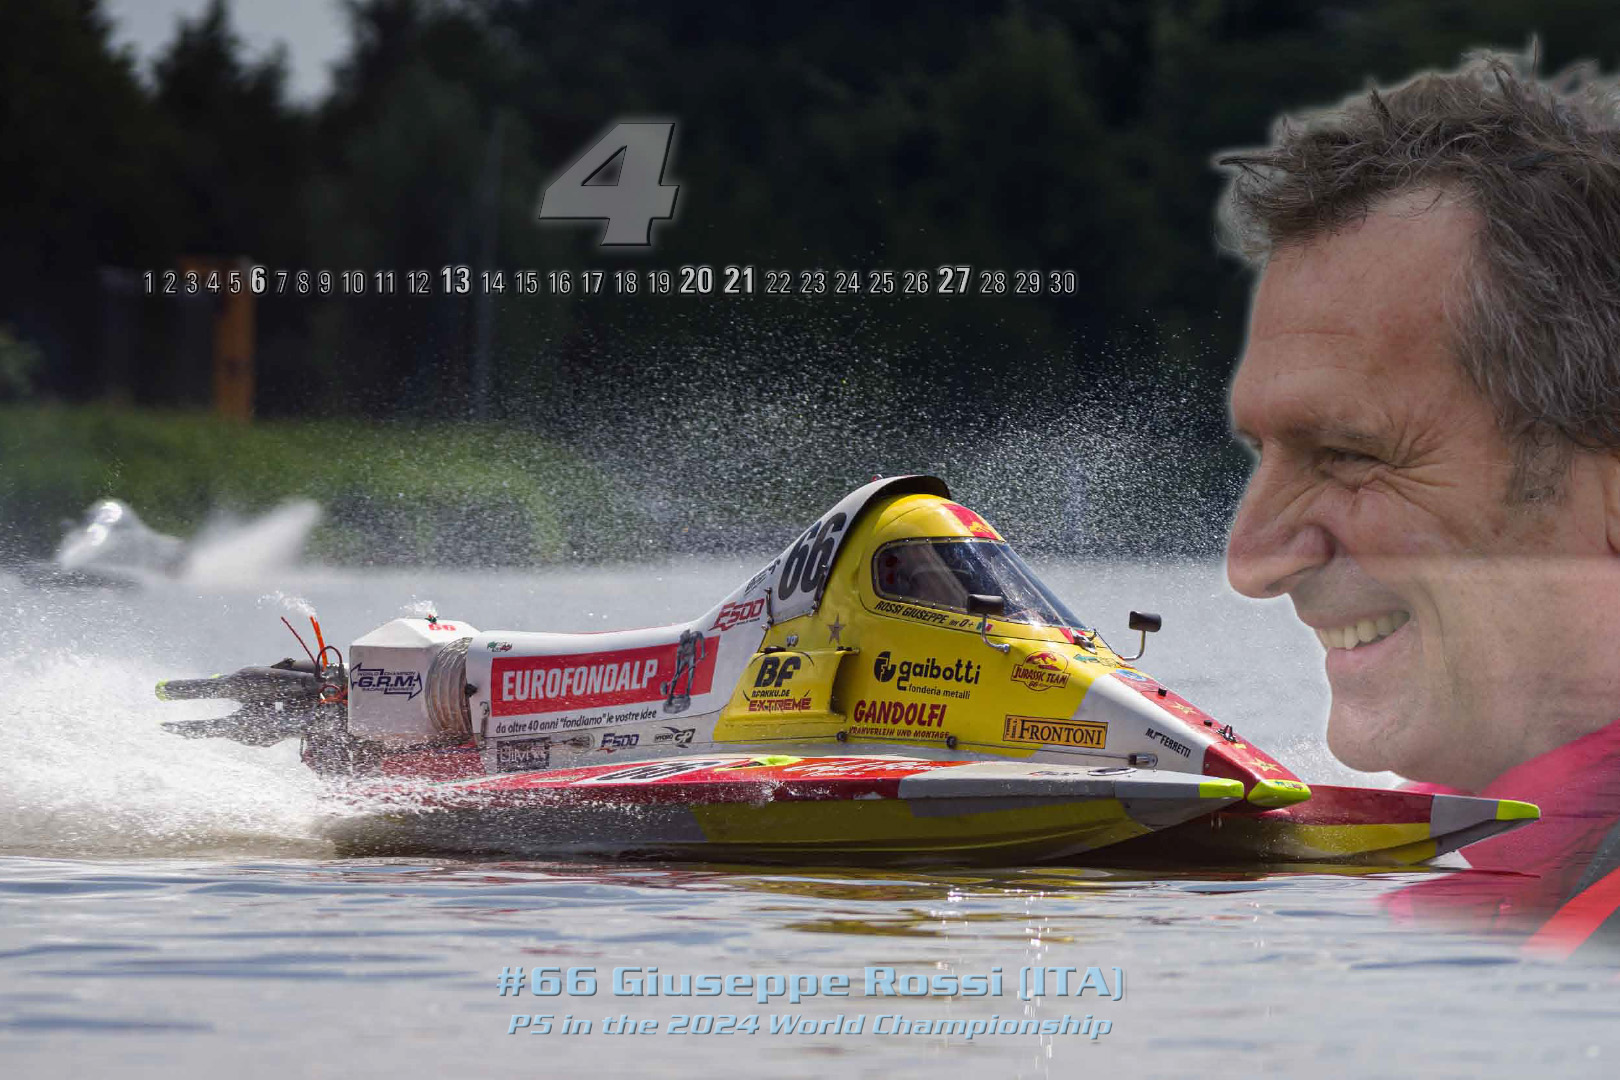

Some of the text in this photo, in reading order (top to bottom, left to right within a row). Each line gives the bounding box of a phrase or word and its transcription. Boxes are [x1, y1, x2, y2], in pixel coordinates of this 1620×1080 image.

[778, 512, 847, 600] 66
[875, 601, 904, 615] ROSSI
[902, 606, 949, 624] GIUSEPPE
[502, 659, 659, 701] EUROFONDALP
[754, 656, 801, 688] BF
[897, 658, 981, 691] gaibotti
[1014, 666, 1068, 685] JURASSIC TEAM
[908, 684, 970, 699] fonderia metalli
[749, 698, 812, 712] EXTREME
[854, 700, 948, 728] GANDOLFI
[496, 723, 506, 734] da
[508, 722, 528, 733] oltre
[528, 720, 539, 730] 40
[540, 719, 559, 730] anni
[606, 712, 615, 723] le
[615, 711, 640, 722] vostre
[640, 708, 657, 720] idee
[1019, 719, 1103, 745] FRONTONI
[601, 733, 639, 748] F500
[675, 732, 692, 744] GP
[897, 729, 912, 737] UND
[913, 730, 950, 739] MONTAGE
[1160, 734, 1192, 758] FERRETTI
